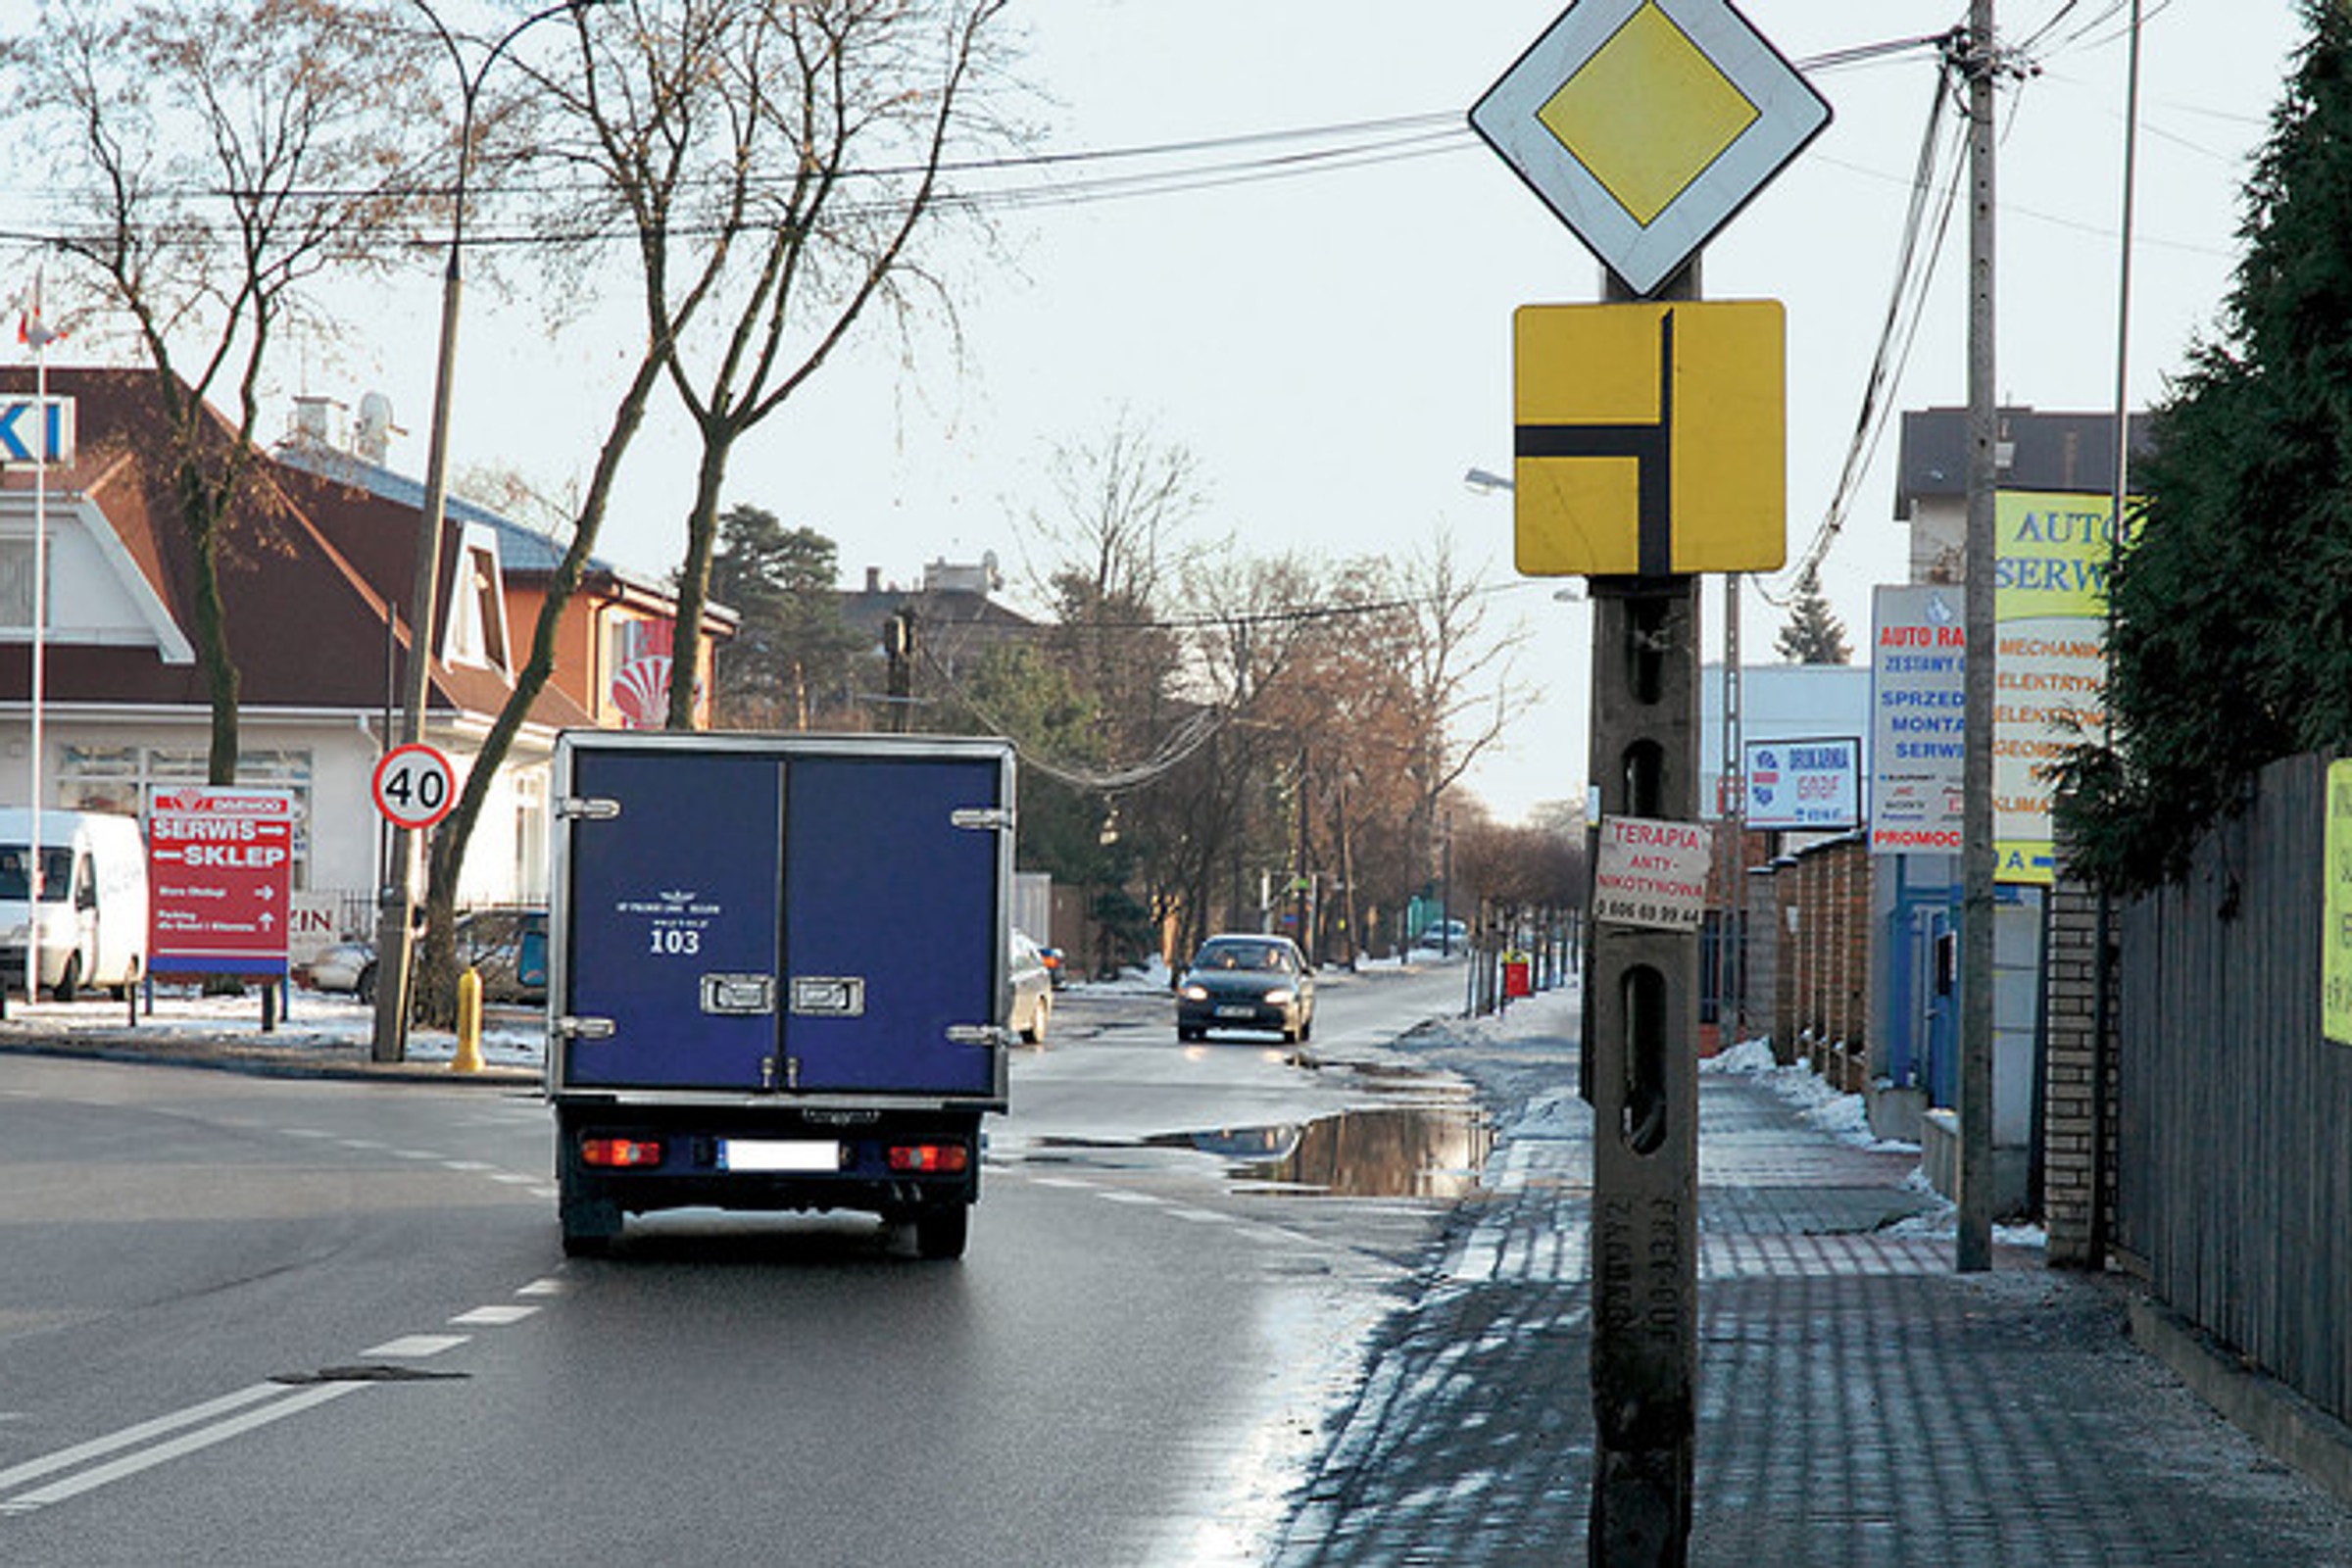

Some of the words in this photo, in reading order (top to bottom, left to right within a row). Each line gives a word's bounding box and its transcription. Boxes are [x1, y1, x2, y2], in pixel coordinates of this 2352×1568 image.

[1880, 626, 1933, 647] AUTO
[1938, 626, 1965, 647] RA
[1886, 657, 1955, 672] ZESTAWY
[1882, 691, 1966, 707] SPRZED
[385, 767, 444, 808] 40
[155, 820, 257, 841] SERWIS
[1615, 823, 1699, 851] TERAPIA
[1875, 830, 1962, 848] PROMOC
[184, 845, 285, 867] SKLEP
[1598, 873, 1703, 898] NIKOTYNOWA
[651, 930, 699, 954] 103
